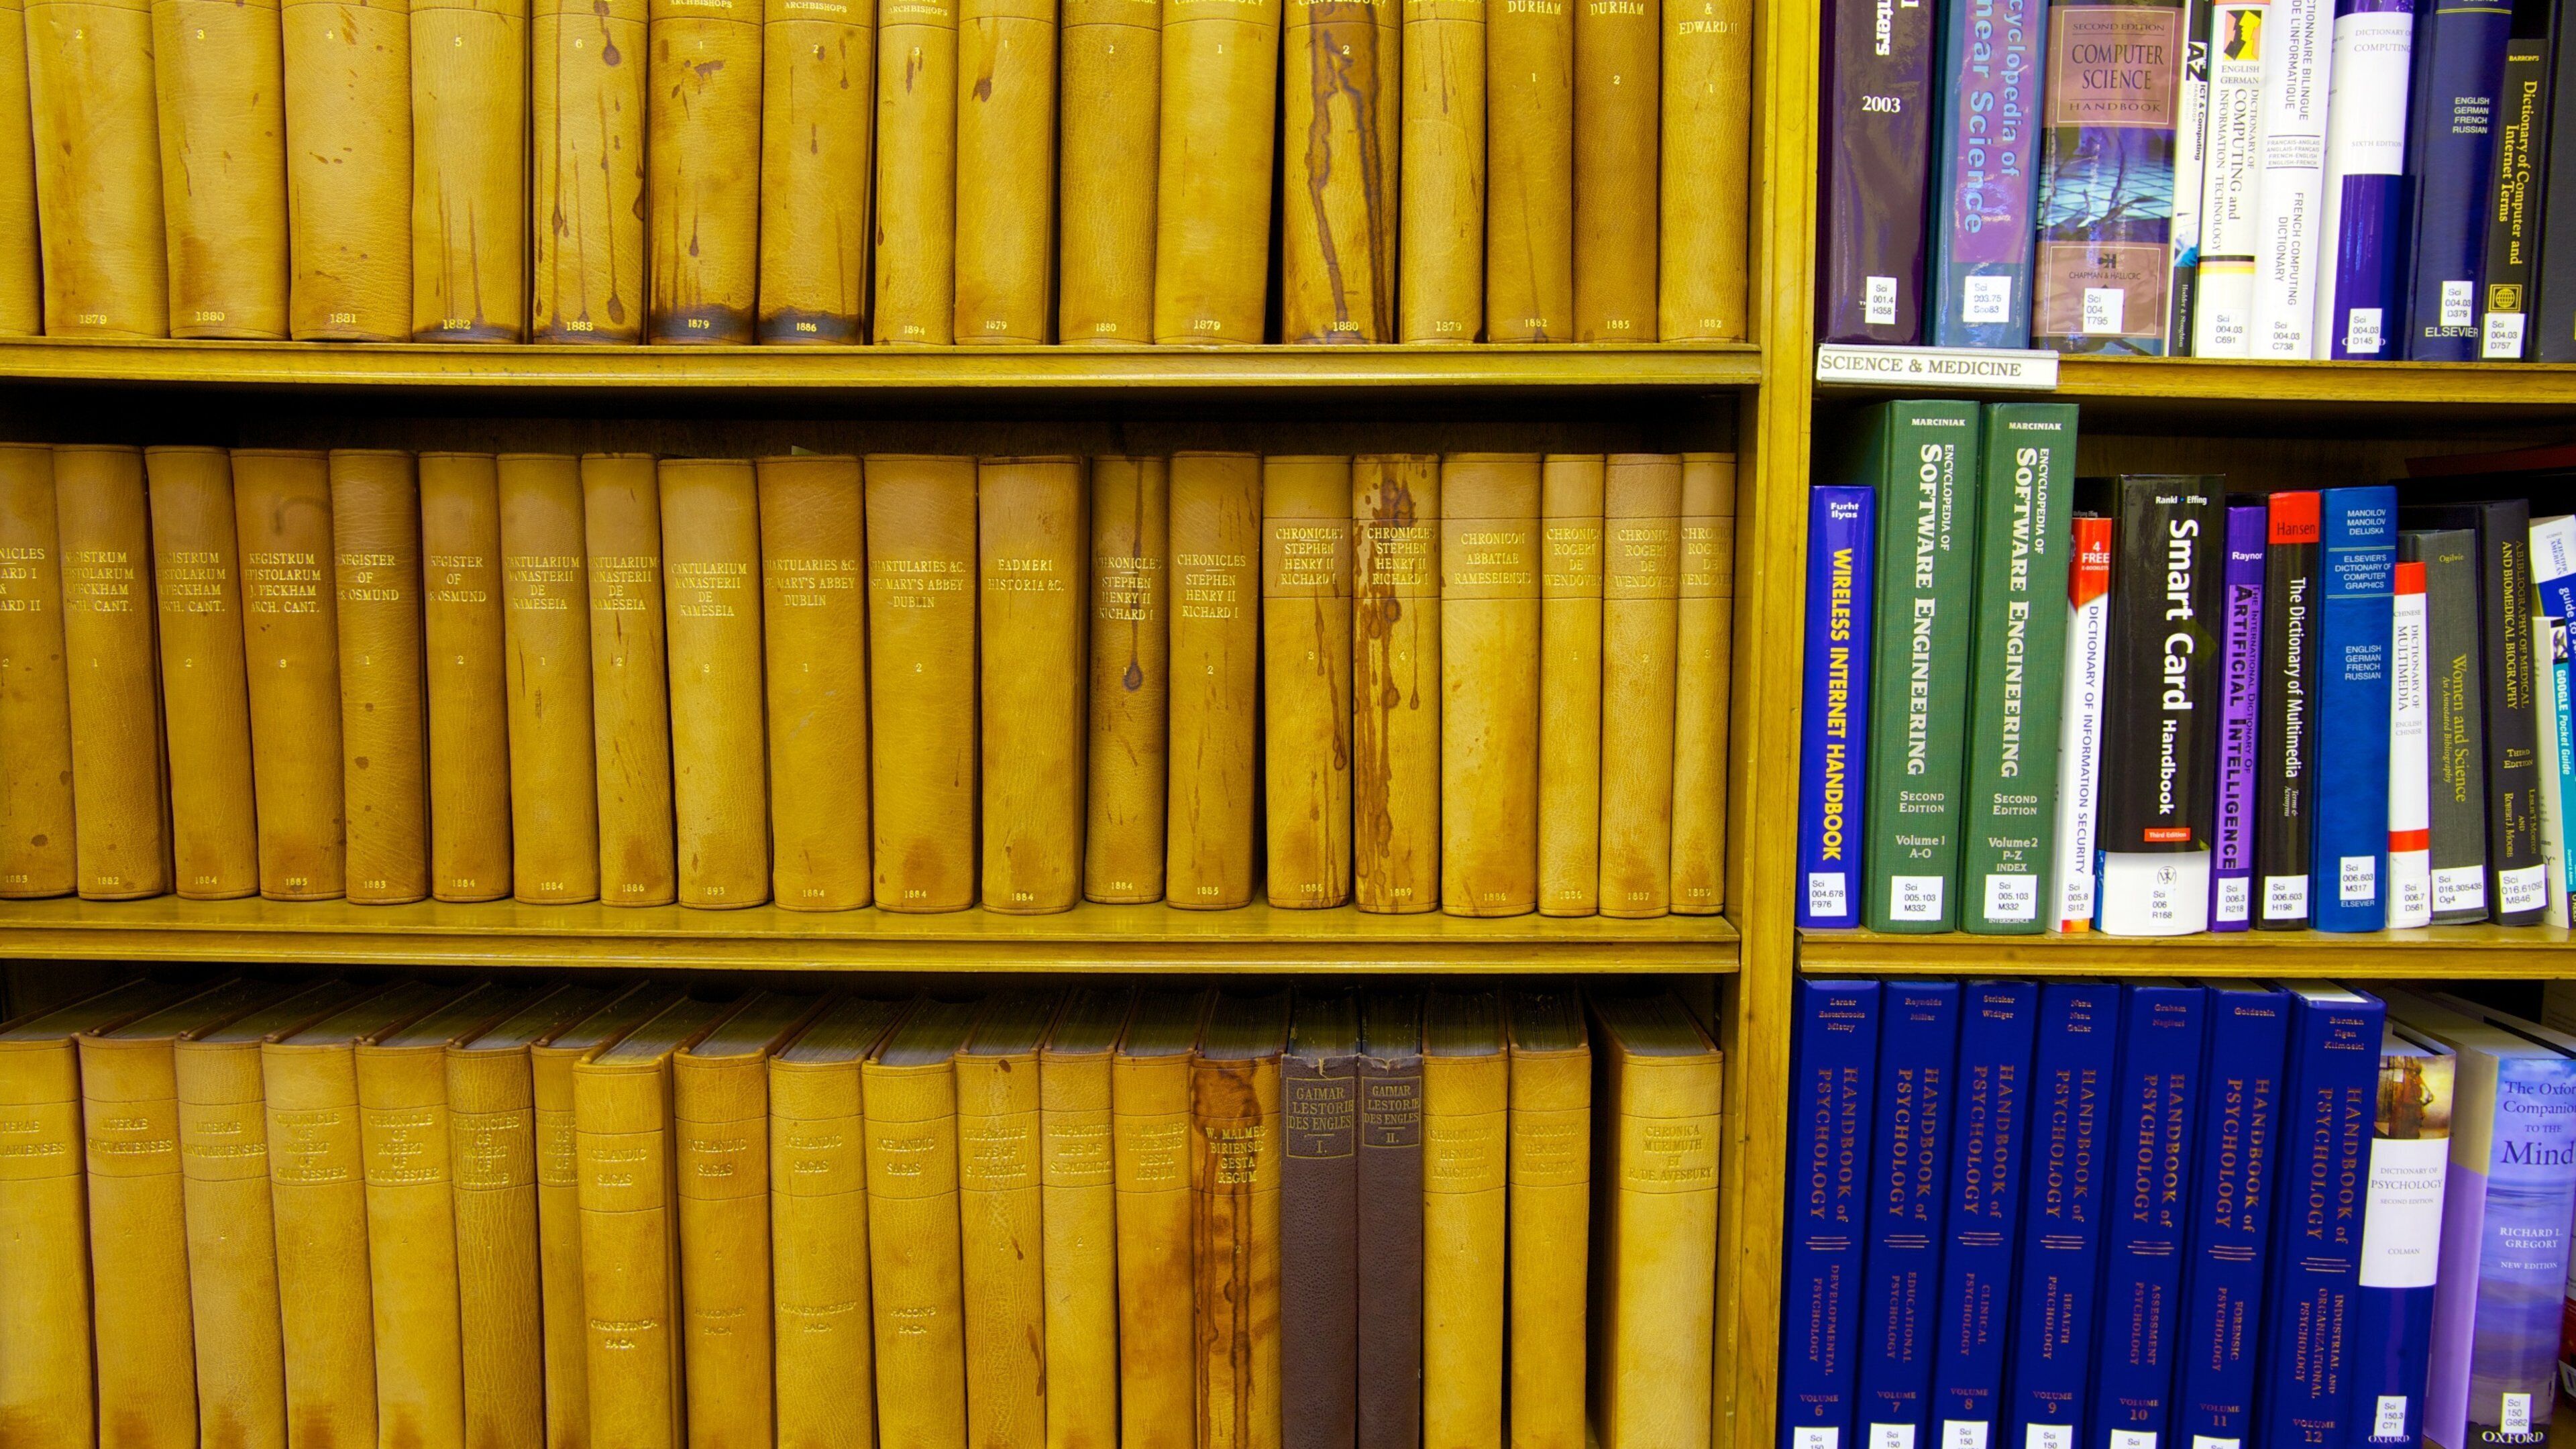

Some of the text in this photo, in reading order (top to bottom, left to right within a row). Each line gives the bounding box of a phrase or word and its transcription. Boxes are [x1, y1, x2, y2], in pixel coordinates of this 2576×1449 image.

[1509, 1, 1562, 15] DURHAM
[1591, 3, 1644, 15] DURHAM
[1679, 21, 1727, 35] EDWARD
[76, 30, 82, 39] 2
[197, 30, 204, 39] 3
[455, 38, 462, 47] 5
[2072, 44, 2163, 66] COMPUTER
[2221, 65, 2259, 73] ENGLISH
[2082, 69, 2151, 89] SCIENCE
[2220, 76, 2259, 85] GERMAN
[2299, 68, 2312, 121] BILINGUE
[1862, 96, 1900, 112] 2003
[2070, 101, 2161, 112] HANDBOOK
[2230, 89, 2247, 193] COMPUTING
[1964, 91, 1994, 233] Science
[2512, 80, 2538, 237] Dictionary Computer
[2212, 89, 2229, 250] INFORMATION TECHNOLOGY
[2499, 125, 2520, 222] Internet Terms
[2274, 217, 2288, 282] DICTIONARY
[2288, 193, 2304, 305] FRENCH COMPUTING
[1874, 296, 1894, 304] 001.4
[1873, 307, 1892, 315] H358
[2087, 305, 2103, 313] 004
[78, 315, 107, 325] 1879
[195, 312, 225, 322] 1880
[329, 314, 357, 323] 1881
[2086, 316, 2108, 325] T795
[443, 320, 471, 329] 1882
[566, 322, 593, 331] 1883
[688, 320, 710, 329] 1879
[796, 323, 817, 332] 1886
[904, 325, 926, 335] 1894
[985, 321, 1007, 330] 1879
[1095, 323, 1116, 332] 1880
[1193, 320, 1220, 330] 1879
[1332, 322, 1358, 331] 1880
[1436, 322, 1461, 332] 1879
[1607, 320, 1630, 329] 1885
[2216, 326, 2243, 334] 004.03
[2353, 326, 2379, 335] 004.03
[2426, 327, 2478, 337] ELSEVIER
[2273, 332, 2300, 341] 004.03
[2353, 337, 2373, 345] D145
[2272, 342, 2294, 350] C738
[2491, 341, 2511, 350] D757
[1821, 356, 2021, 376] SCIENCE & MEDICINE
[1912, 418, 1966, 426] MARCINIAK
[2009, 422, 2061, 430] MARCINIAK
[2277, 522, 2316, 535] Hansen
[1377, 542, 1426, 555] STEPHEN
[1177, 554, 1246, 567] CHRONICLES
[2082, 553, 2109, 563] FREE
[2232, 551, 2263, 561] Raynor
[1376, 557, 1413, 570] HENRY
[358, 572, 373, 583] OF
[447, 574, 462, 584] OF
[1185, 574, 1235, 586] STEPHEN
[2343, 573, 2385, 581] COMPUTER
[928, 578, 963, 590] ABBEY
[2345, 581, 2385, 590] GRAPHICS
[259, 585, 317, 596] PECKHAM
[350, 589, 399, 600] OSMUND
[530, 584, 546, 596] DE
[1186, 589, 1236, 602] HENRY II
[437, 590, 486, 602] OSMUND
[698, 591, 712, 602] DE
[284, 601, 320, 612] CANT.
[893, 596, 934, 608] DUBLIN
[1907, 444, 1943, 775] SOFTWARE ENGINEERING
[2001, 447, 2037, 778] SOFTWARE ENGINEERING
[2346, 645, 2381, 653] ENGLISH
[2345, 654, 2381, 663] GERMAN
[2159, 519, 2200, 815] Smart Card Handbook
[2346, 663, 2380, 672] FRENCH
[2345, 672, 2381, 681] RUSSIAN
[1822, 548, 1853, 861] WIRELESS INTERNET HANDBOOK
[2286, 699, 2303, 777] Multimedia
[2455, 748, 2469, 802] Science
[1900, 791, 1944, 801] SECOND
[1994, 794, 2037, 804] SECOND
[1899, 803, 1944, 813] EDITION
[1992, 804, 2037, 815] EDITION
[1896, 835, 1937, 846] Volume
[1988, 837, 2029, 849] Volume
[2343, 874, 2373, 883] 006.603
[1812, 890, 1843, 898] 004.678
[1904, 894, 1936, 902] 005.103
[1998, 892, 2029, 900] 005.103
[2226, 895, 2245, 903] 006.3
[2272, 894, 2302, 902] 006.603
[1904, 904, 1926, 912] M332
[2153, 900, 2167, 908] 006
[1297, 1087, 1344, 1100] GAIMAR
[1373, 1085, 1411, 1097] GAIMAR
[2506, 1081, 2534, 1095] The
[1292, 1100, 1354, 1115] LESTORIE
[1367, 1098, 1419, 1111] LESTORIE
[1288, 1116, 1351, 1129] DES ENGLES
[1364, 1111, 1419, 1123] DES ENGLES
[1837, 1067, 1859, 1199] HANDBOOK
[1917, 1068, 1939, 1197] HANDBOOK
[1991, 1064, 2015, 1195] HANDBOOK
[1386, 1132, 1399, 1143] II.
[1964, 1066, 1988, 1215] PSYCHOLOGY
[1811, 1069, 1833, 1220] PSYCHOLOGY
[1889, 1069, 1913, 1218] PSYCHOLOGY
[2500, 1140, 2575, 1165] Mind
[1221, 1155, 1256, 1168] GESTA
[1218, 1170, 1256, 1184] REGUM
[2371, 1179, 2443, 1190] PSYCHOLOGY
[2500, 1228, 2551, 1238] RICHARD
[2506, 1239, 2558, 1249] GREGORY
[1800, 1394, 1839, 1402] VOLUME
[1892, 1402, 1900, 1413] 7
[1965, 1398, 1973, 1410] 8
[2048, 1401, 2056, 1413] 9
[1815, 1405, 1823, 1416] 6
[2131, 1409, 2147, 1421] 10
[2506, 1418, 2527, 1427] G862
[2304, 1431, 2322, 1443] 12
